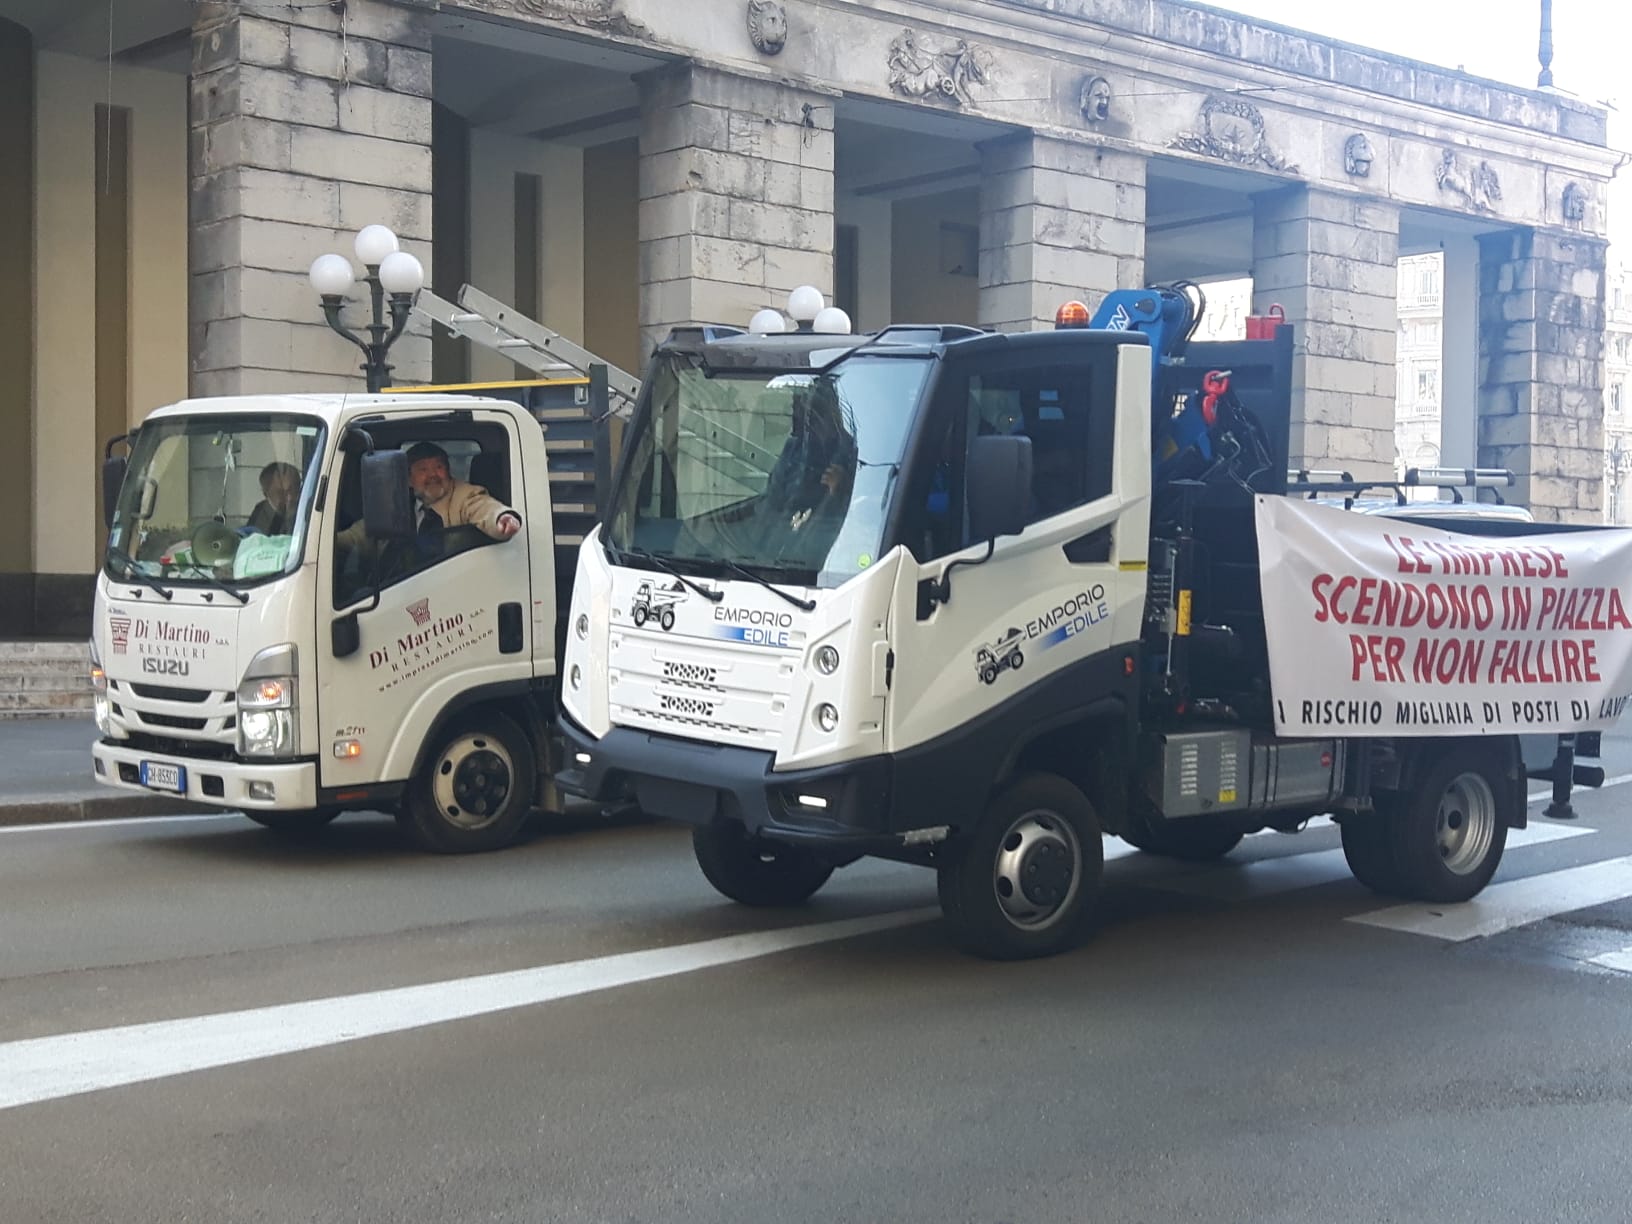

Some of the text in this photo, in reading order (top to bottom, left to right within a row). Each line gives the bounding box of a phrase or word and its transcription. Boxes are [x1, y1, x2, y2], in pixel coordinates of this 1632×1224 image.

[1383, 533, 1569, 579] LE IMPRESE
[714, 606, 793, 628] EMPORIO
[1025, 583, 1105, 639] EMPORIO
[1064, 602, 1109, 638] EDILE
[1312, 573, 1632, 631] SCENDONO IN PIAZZA
[135, 618, 149, 639] Di
[155, 620, 210, 645] Martino
[369, 646, 389, 669] Di
[397, 612, 464, 655] Martino
[391, 624, 474, 673] RESTAURI
[743, 628, 789, 647] EDILE
[139, 643, 206, 660] RESTAURI
[142, 658, 189, 676] ISUZU
[1349, 634, 1601, 684] PER NON FALLIRE
[1301, 699, 1382, 725] RISCHIO
[1396, 701, 1474, 725] MIGLIAIA
[1484, 701, 1502, 724] DI
[1513, 701, 1560, 723] POSTI
[1572, 700, 1590, 722] DI
